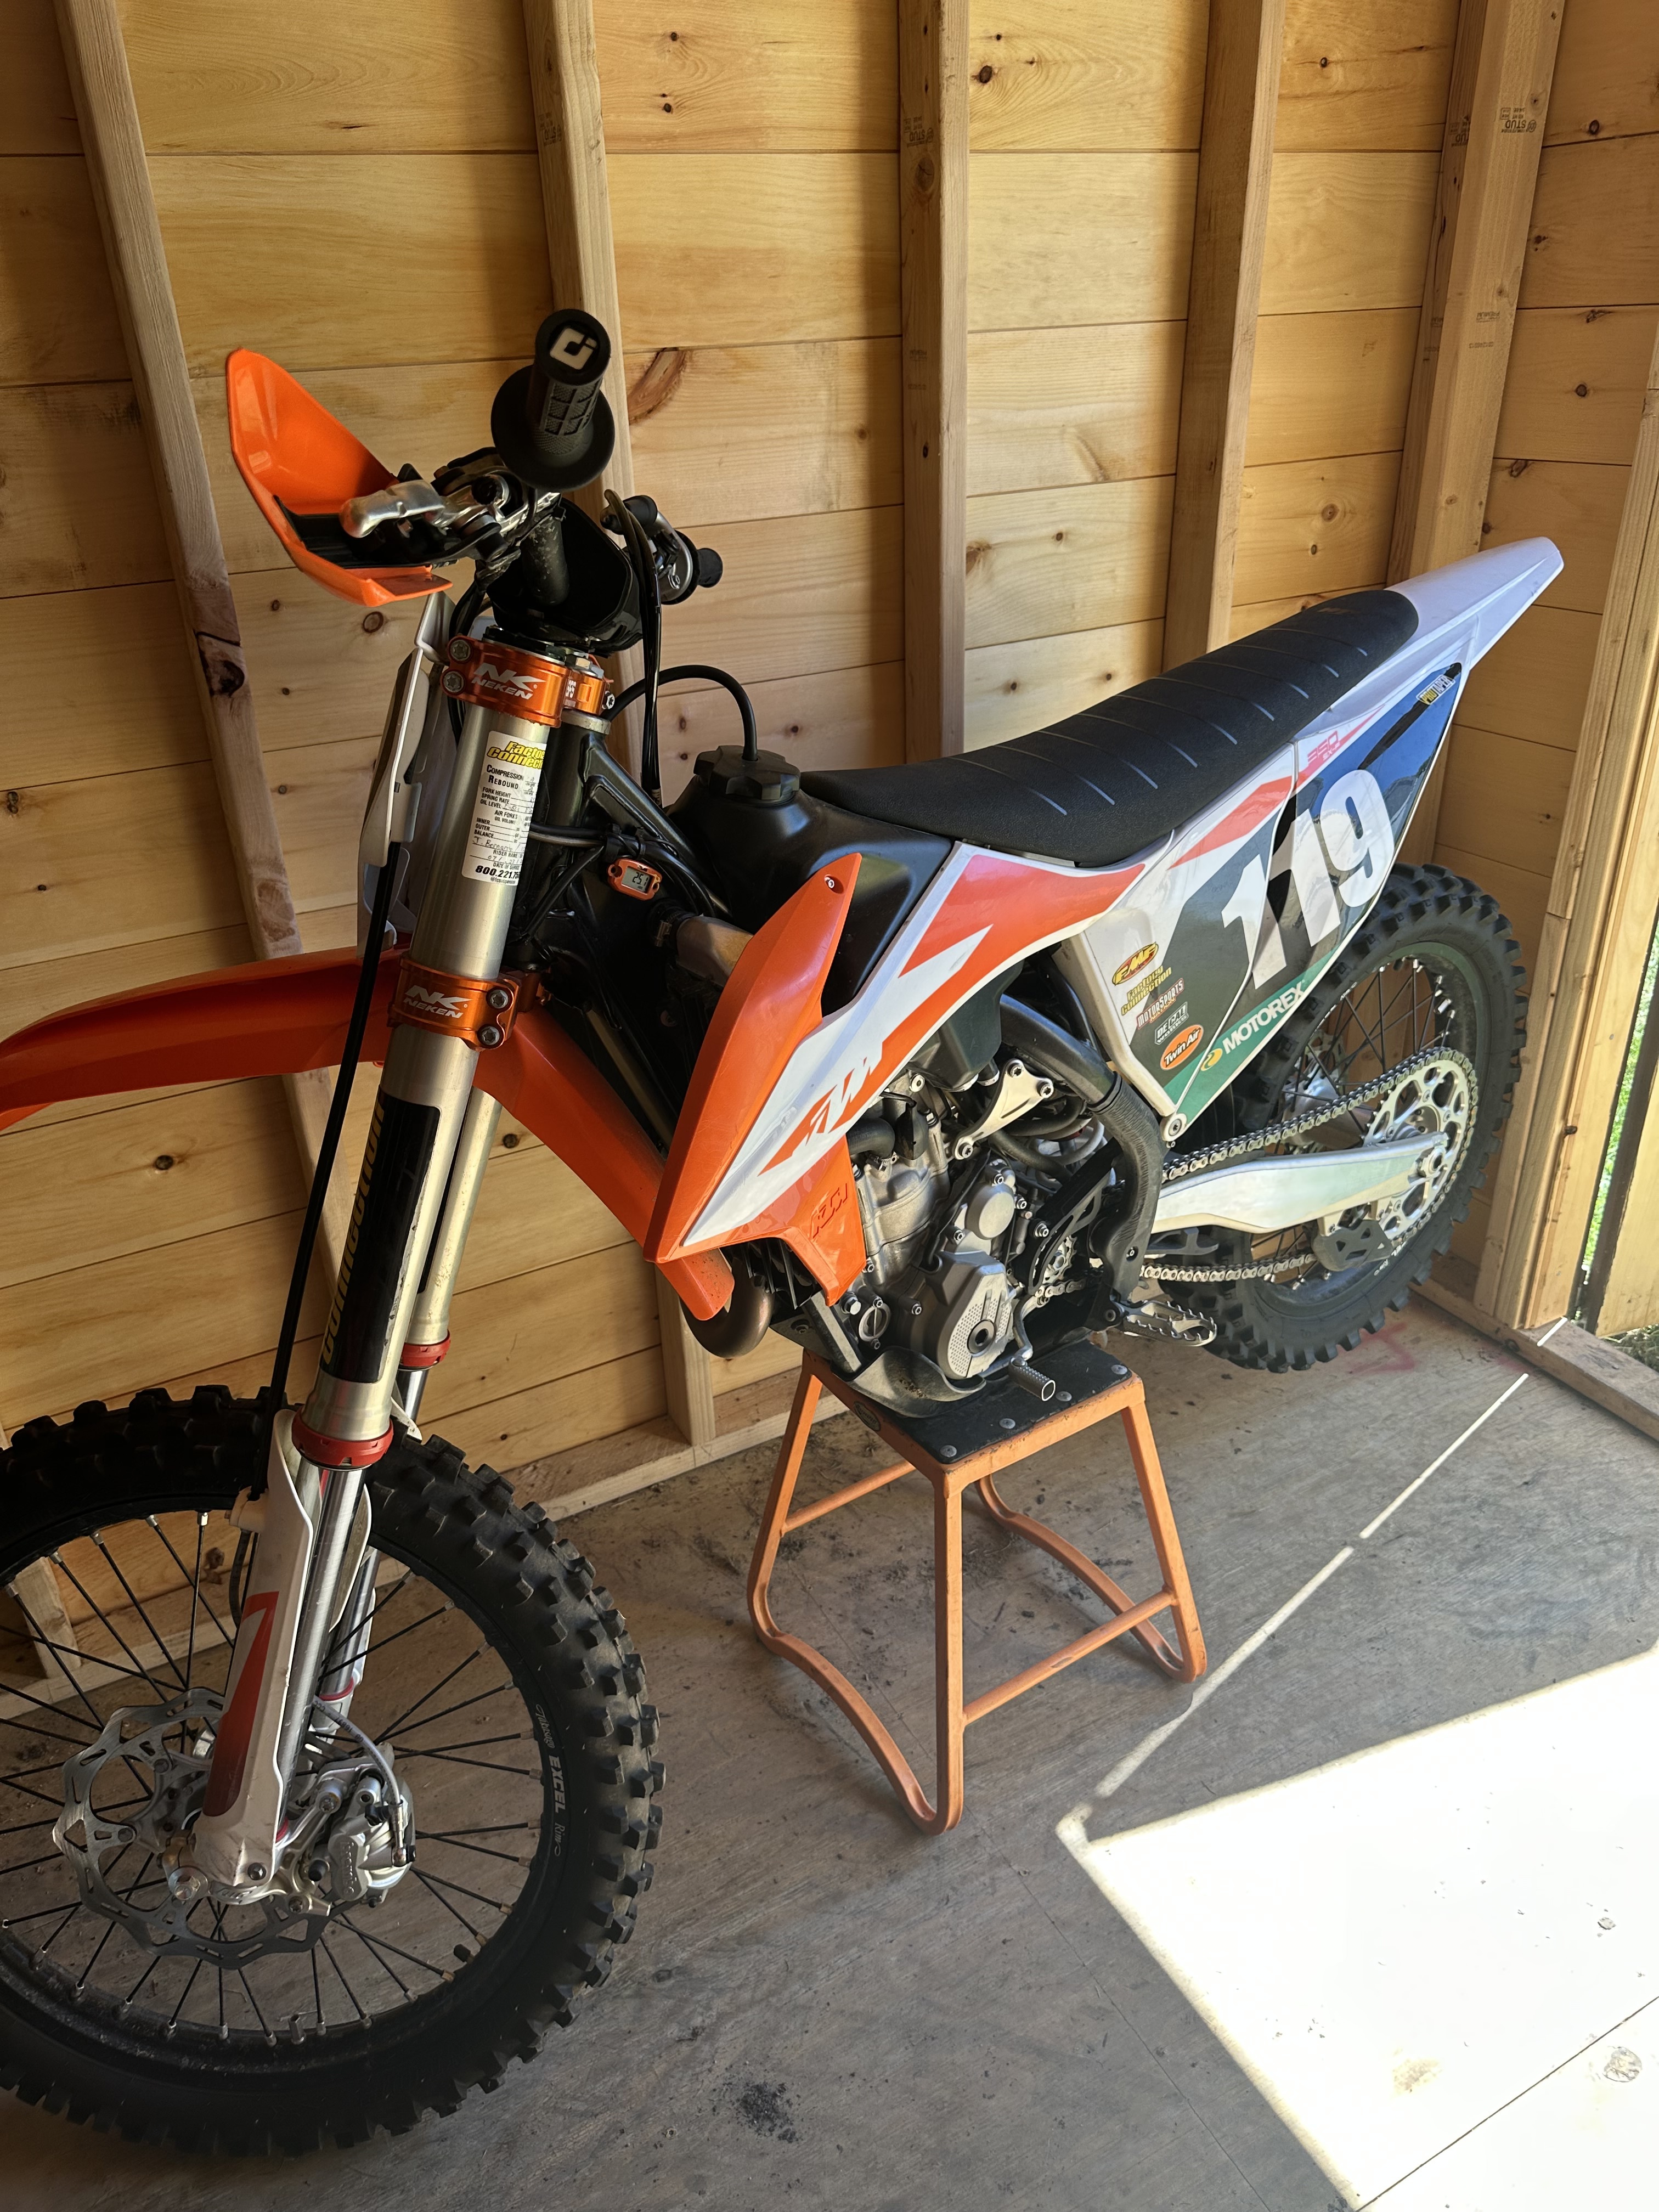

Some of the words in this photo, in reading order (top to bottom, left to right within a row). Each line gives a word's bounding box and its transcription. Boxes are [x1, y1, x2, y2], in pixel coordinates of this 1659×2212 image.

[909, 129, 925, 142] STUD
[1505, 120, 1526, 129] STUD
[471, 677, 533, 699] NEKEN
[481, 793, 498, 802] SPRING
[495, 789, 511, 799] HEIGHT
[474, 829, 494, 839] BALANCE
[475, 823, 490, 831] OUTER
[1221, 769, 1394, 990] 119
[1114, 942, 1156, 986] FMF
[403, 997, 464, 1019] NEKEN
[1222, 981, 1305, 1054] MOTOREX
[1164, 1040, 1186, 1067] Twin
[1186, 1028, 1201, 1049] Air
[549, 1755, 566, 1813] EXCEL
